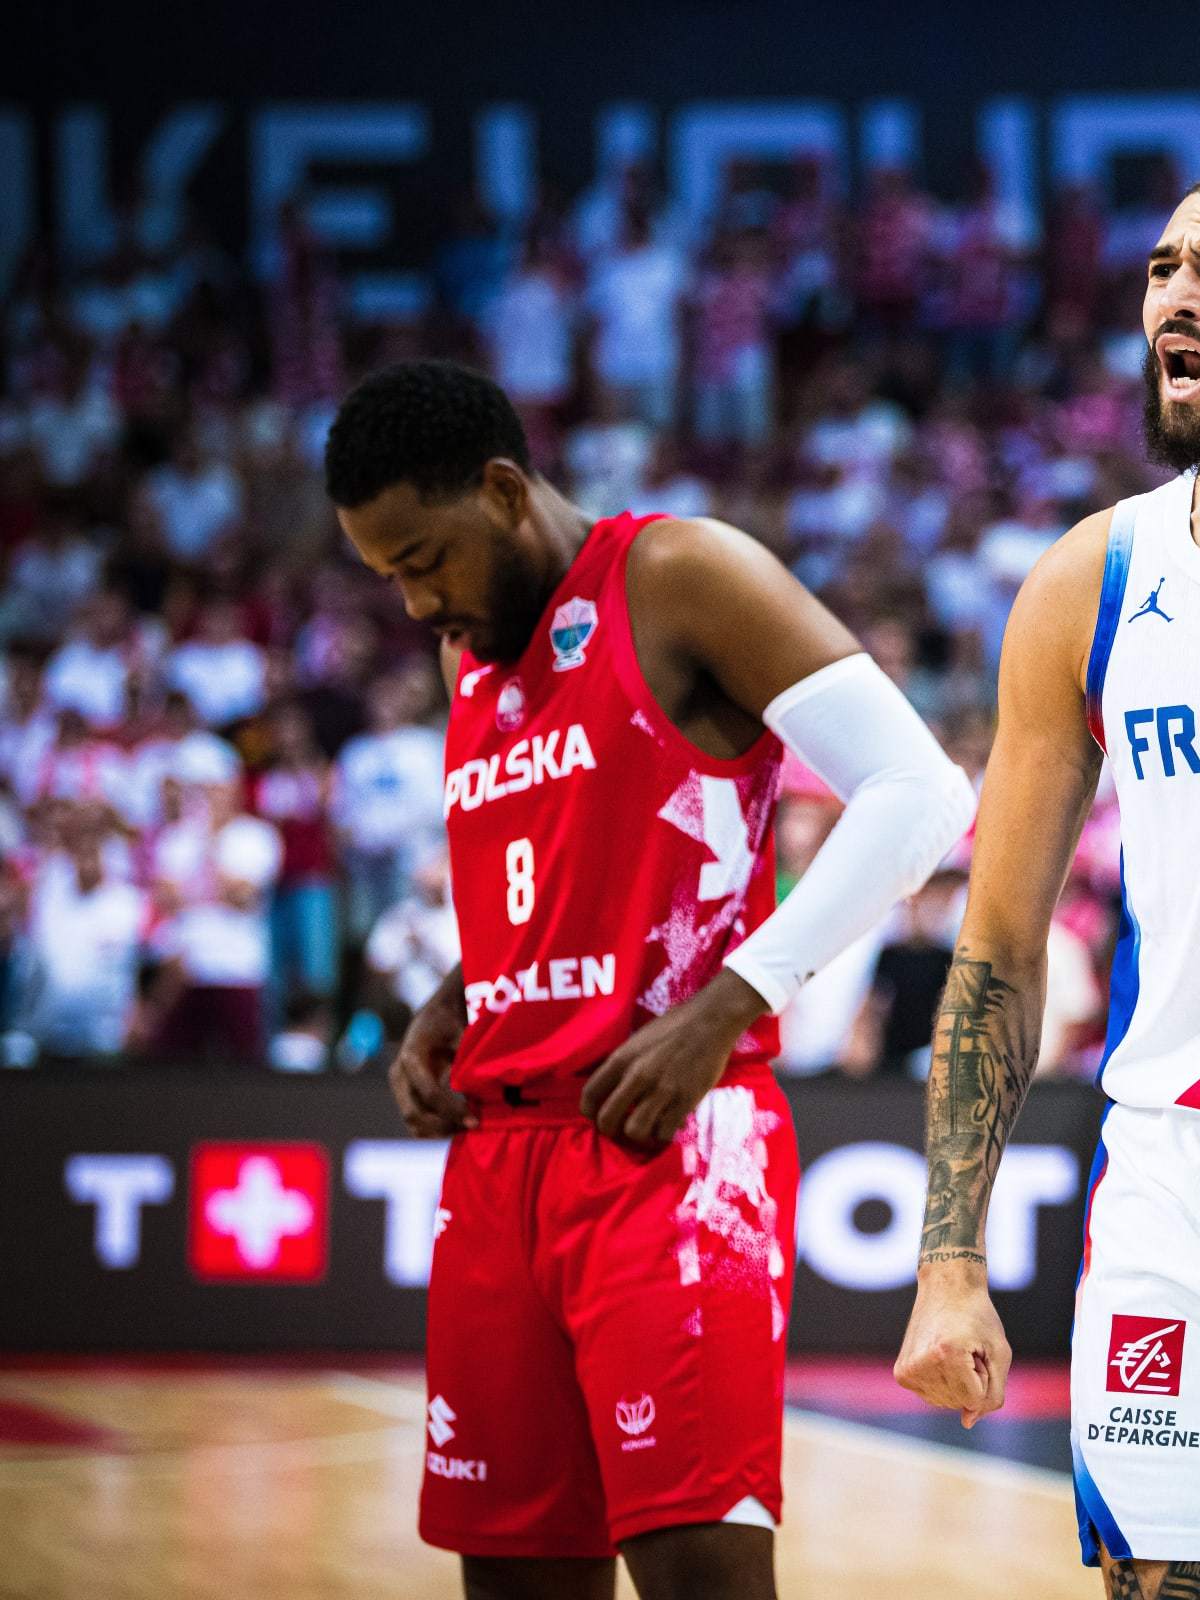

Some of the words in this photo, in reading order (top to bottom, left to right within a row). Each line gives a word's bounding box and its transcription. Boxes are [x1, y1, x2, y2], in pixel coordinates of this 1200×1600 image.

[443, 723, 598, 820] POLSKA
[505, 837, 536, 926] 8
[464, 953, 616, 1026] POLEN
[1087, 1423, 1200, 1448] D'EPARGNE
[1109, 1406, 1177, 1427] CAISSE
